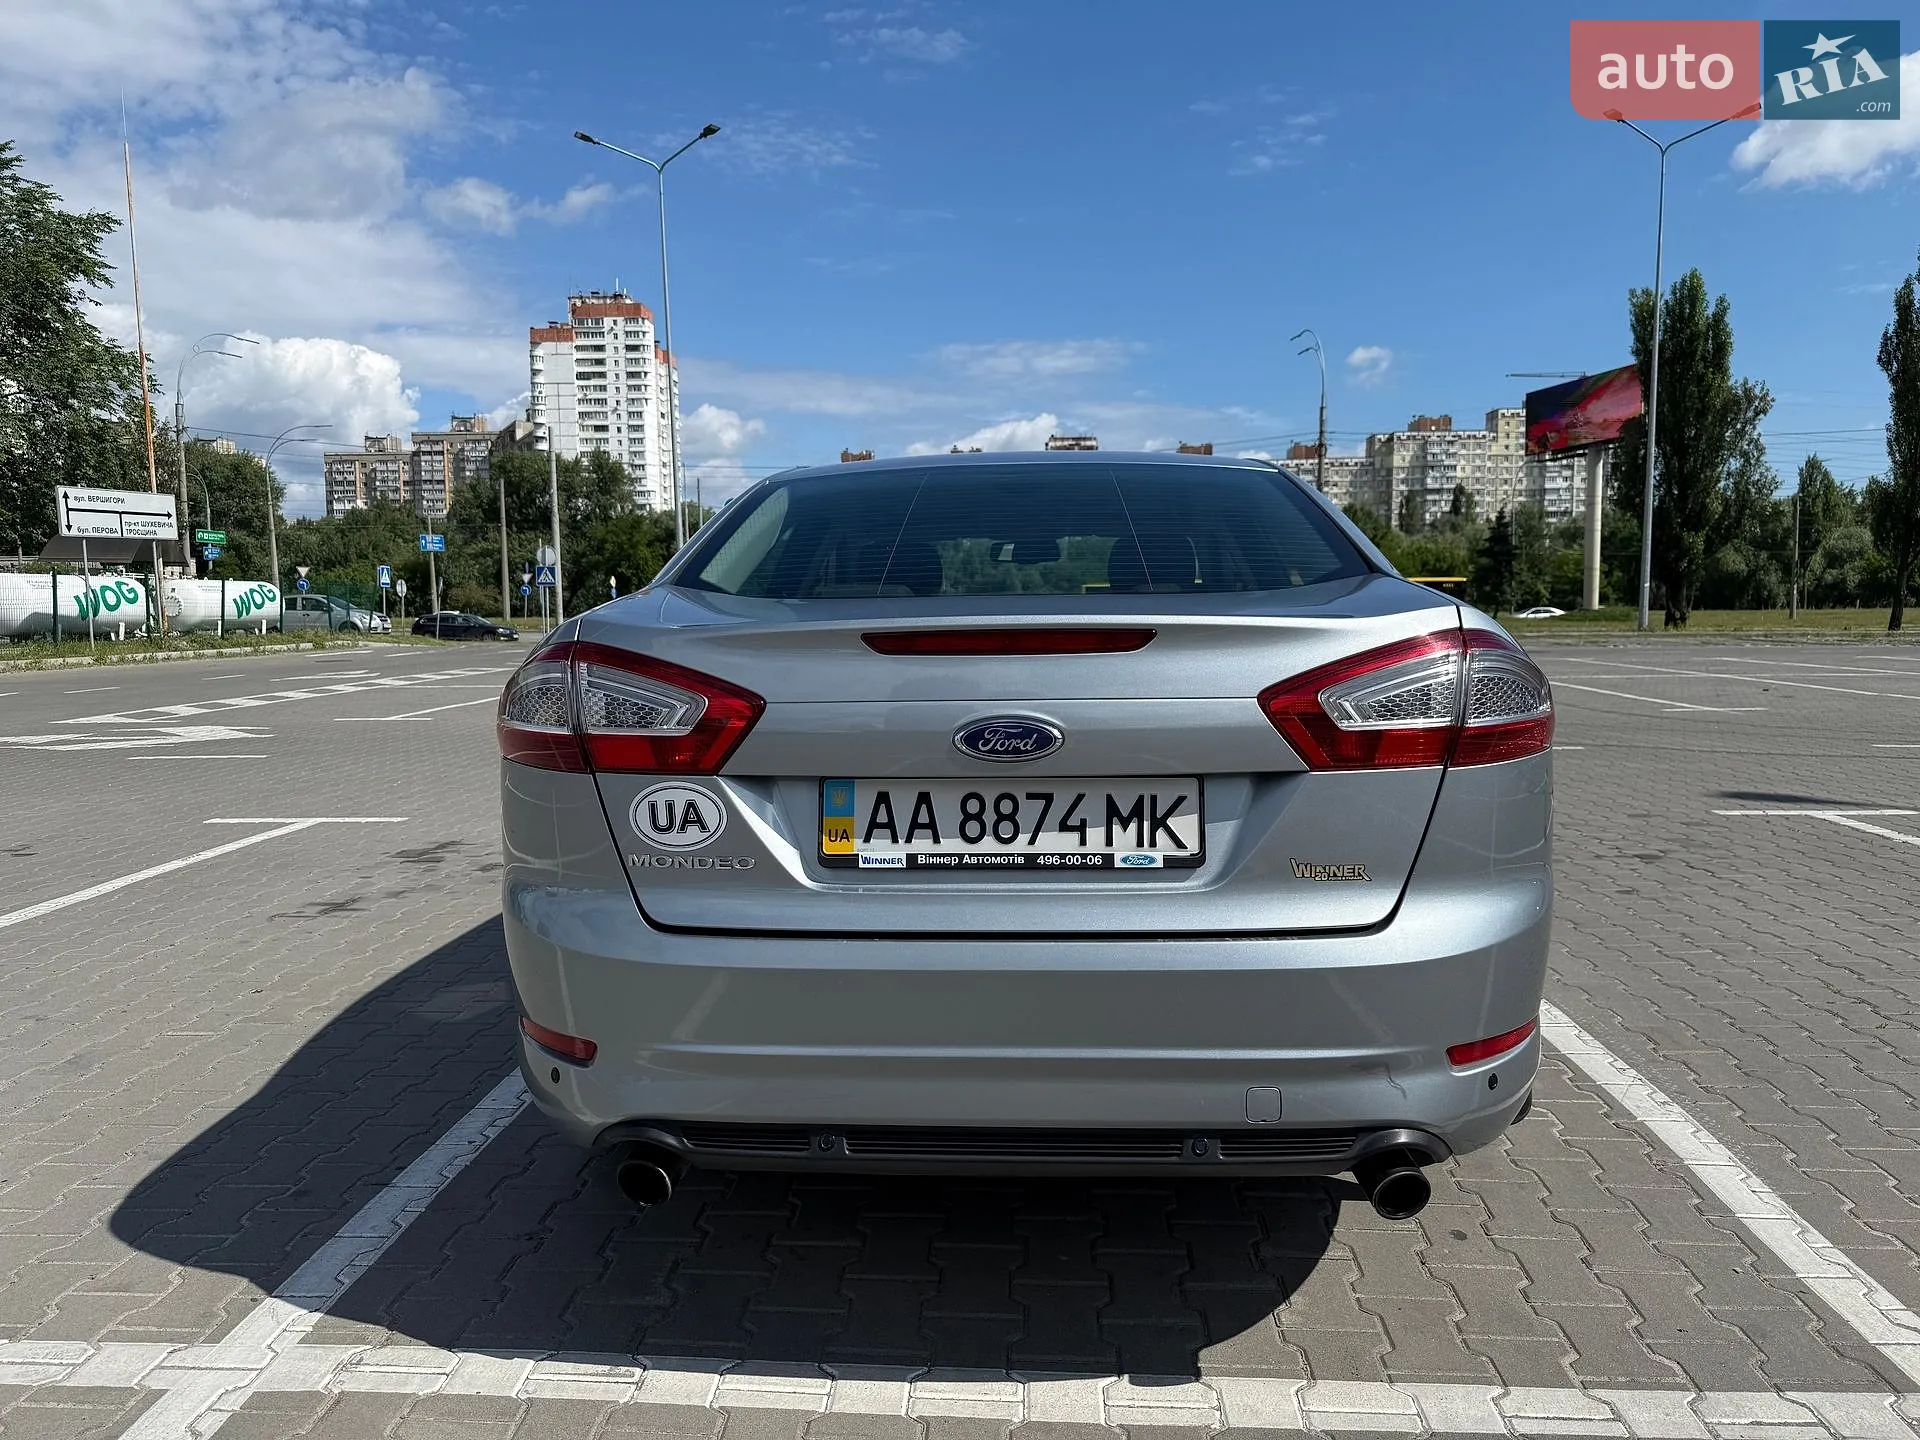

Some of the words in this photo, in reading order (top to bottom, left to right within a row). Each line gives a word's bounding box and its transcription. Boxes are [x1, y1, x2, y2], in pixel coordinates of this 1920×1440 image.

[87, 495, 126, 505] ВЕРШИГОРИ
[92, 526, 119, 535] ПЕРОВА
[140, 520, 174, 529] ШУХЕВИЧА
[73, 580, 139, 621] WOG
[232, 584, 277, 620] WOG
[978, 727, 1038, 751] Ford
[648, 799, 711, 834] UA
[863, 791, 941, 844] AA
[958, 791, 1088, 847] 8874
[1105, 793, 1188, 850] MK
[828, 829, 850, 843] UA
[628, 853, 756, 870] MONDEO
[861, 854, 904, 867] WINNER
[917, 854, 959, 866] Віннер
[962, 854, 1025, 865] Автомотів
[1036, 855, 1103, 866] 496-00-06
[1126, 855, 1150, 865] Ford
[1289, 857, 1372, 881] WINNER
